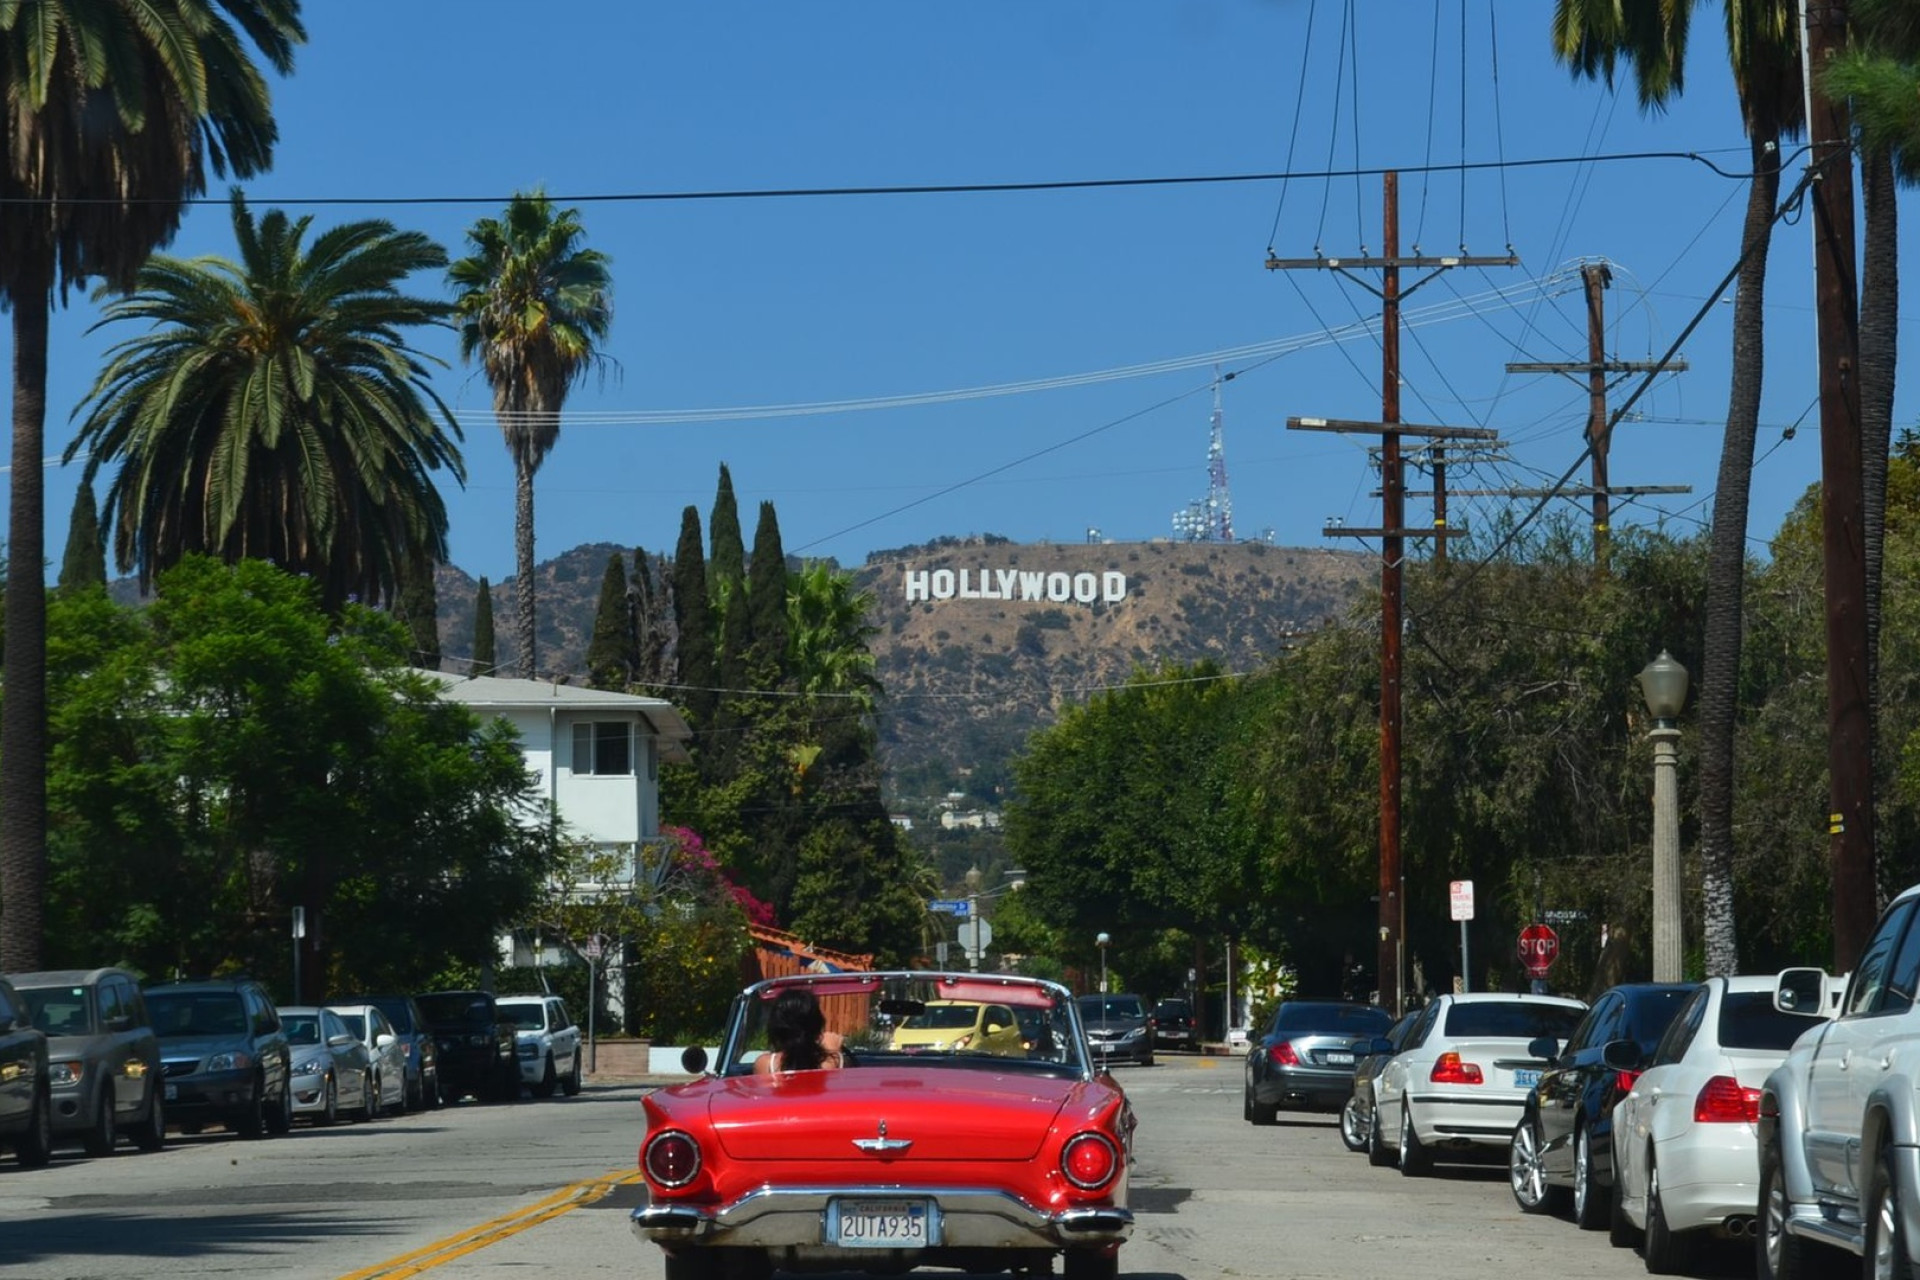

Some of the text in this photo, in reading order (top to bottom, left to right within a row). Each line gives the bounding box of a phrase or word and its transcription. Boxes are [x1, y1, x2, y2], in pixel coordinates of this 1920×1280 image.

[905, 569, 1126, 602] HOLLYWOOD
[1521, 938, 1556, 955] STOP
[844, 1215, 922, 1237] 2UTA935
